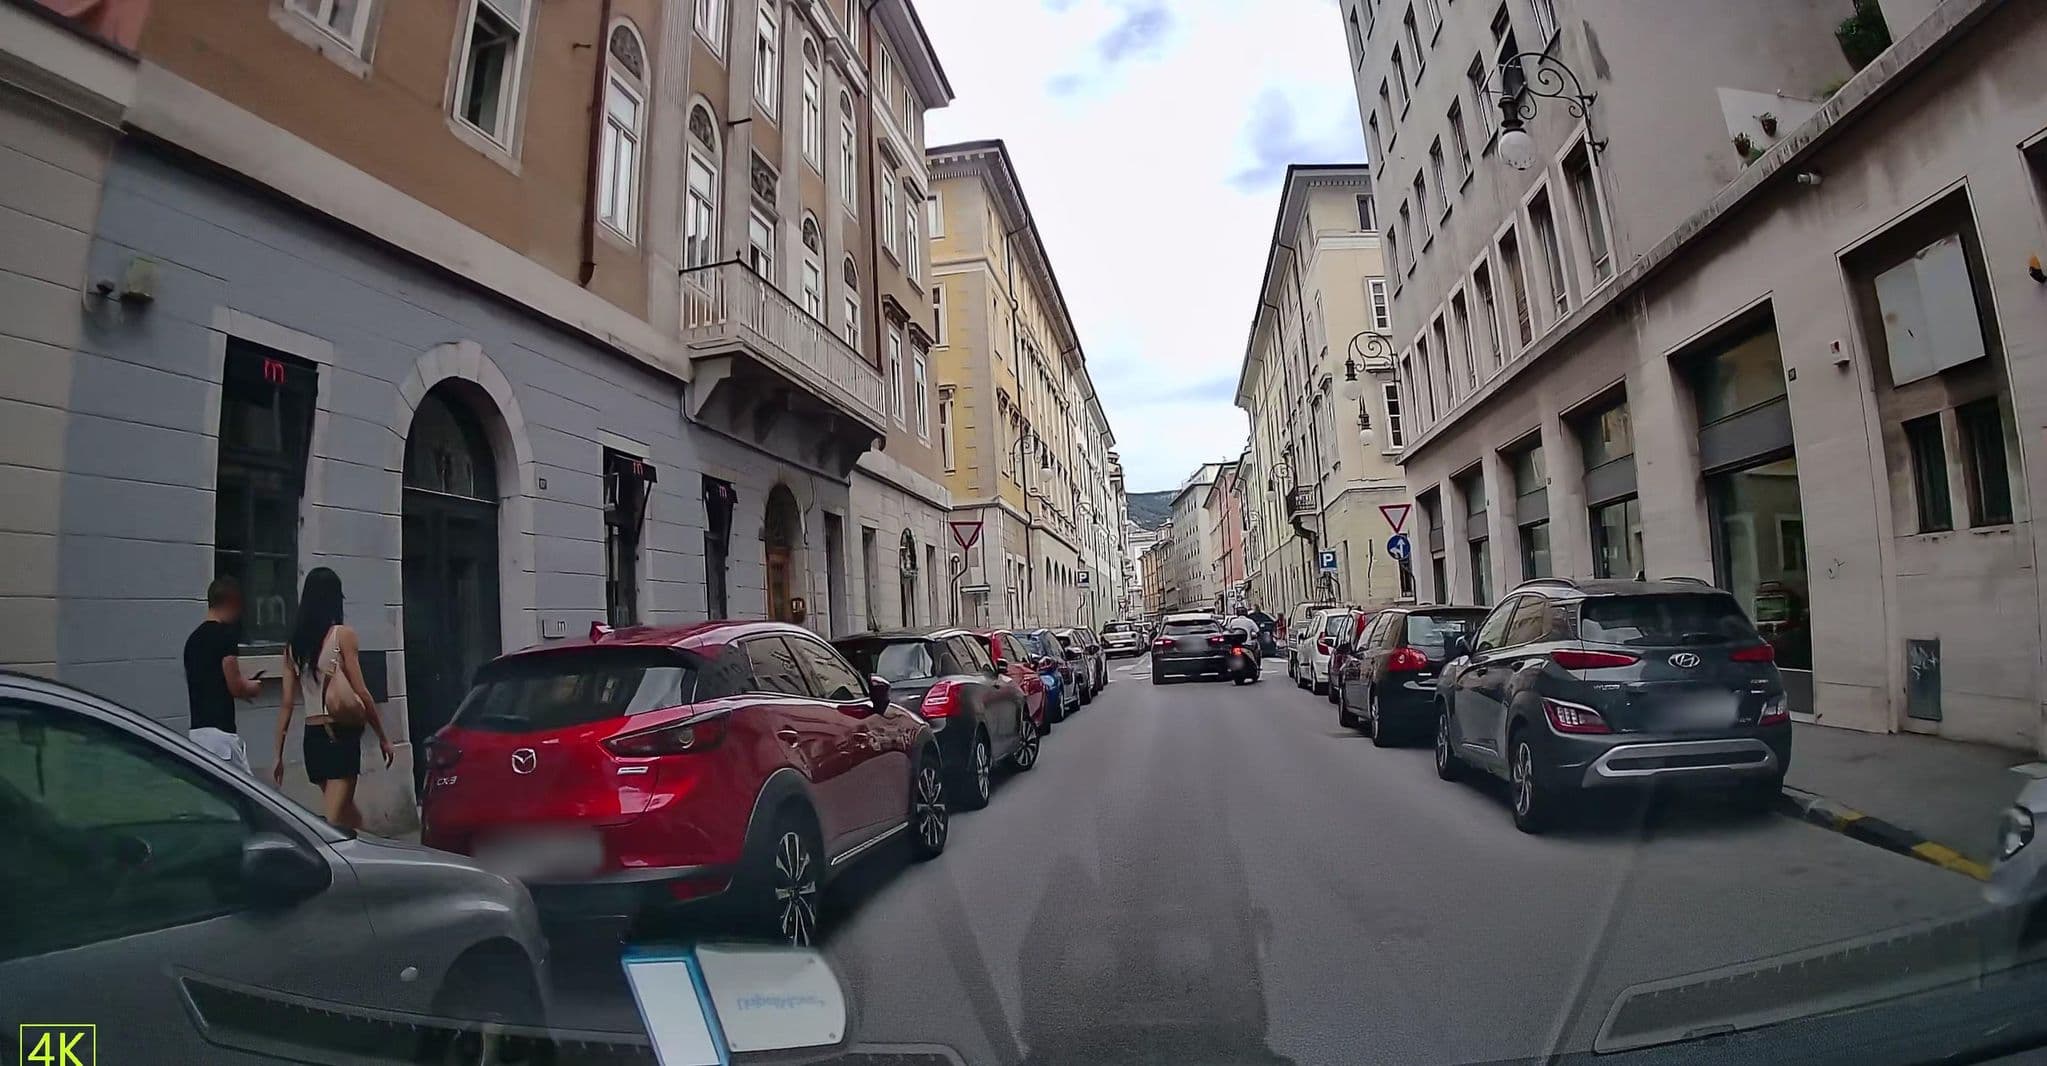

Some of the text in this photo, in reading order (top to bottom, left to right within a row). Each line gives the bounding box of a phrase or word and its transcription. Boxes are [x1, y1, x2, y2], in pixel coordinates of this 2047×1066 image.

[264, 358, 284, 384] m
[1323, 553, 1333, 567] P
[1079, 572, 1087, 582] P
